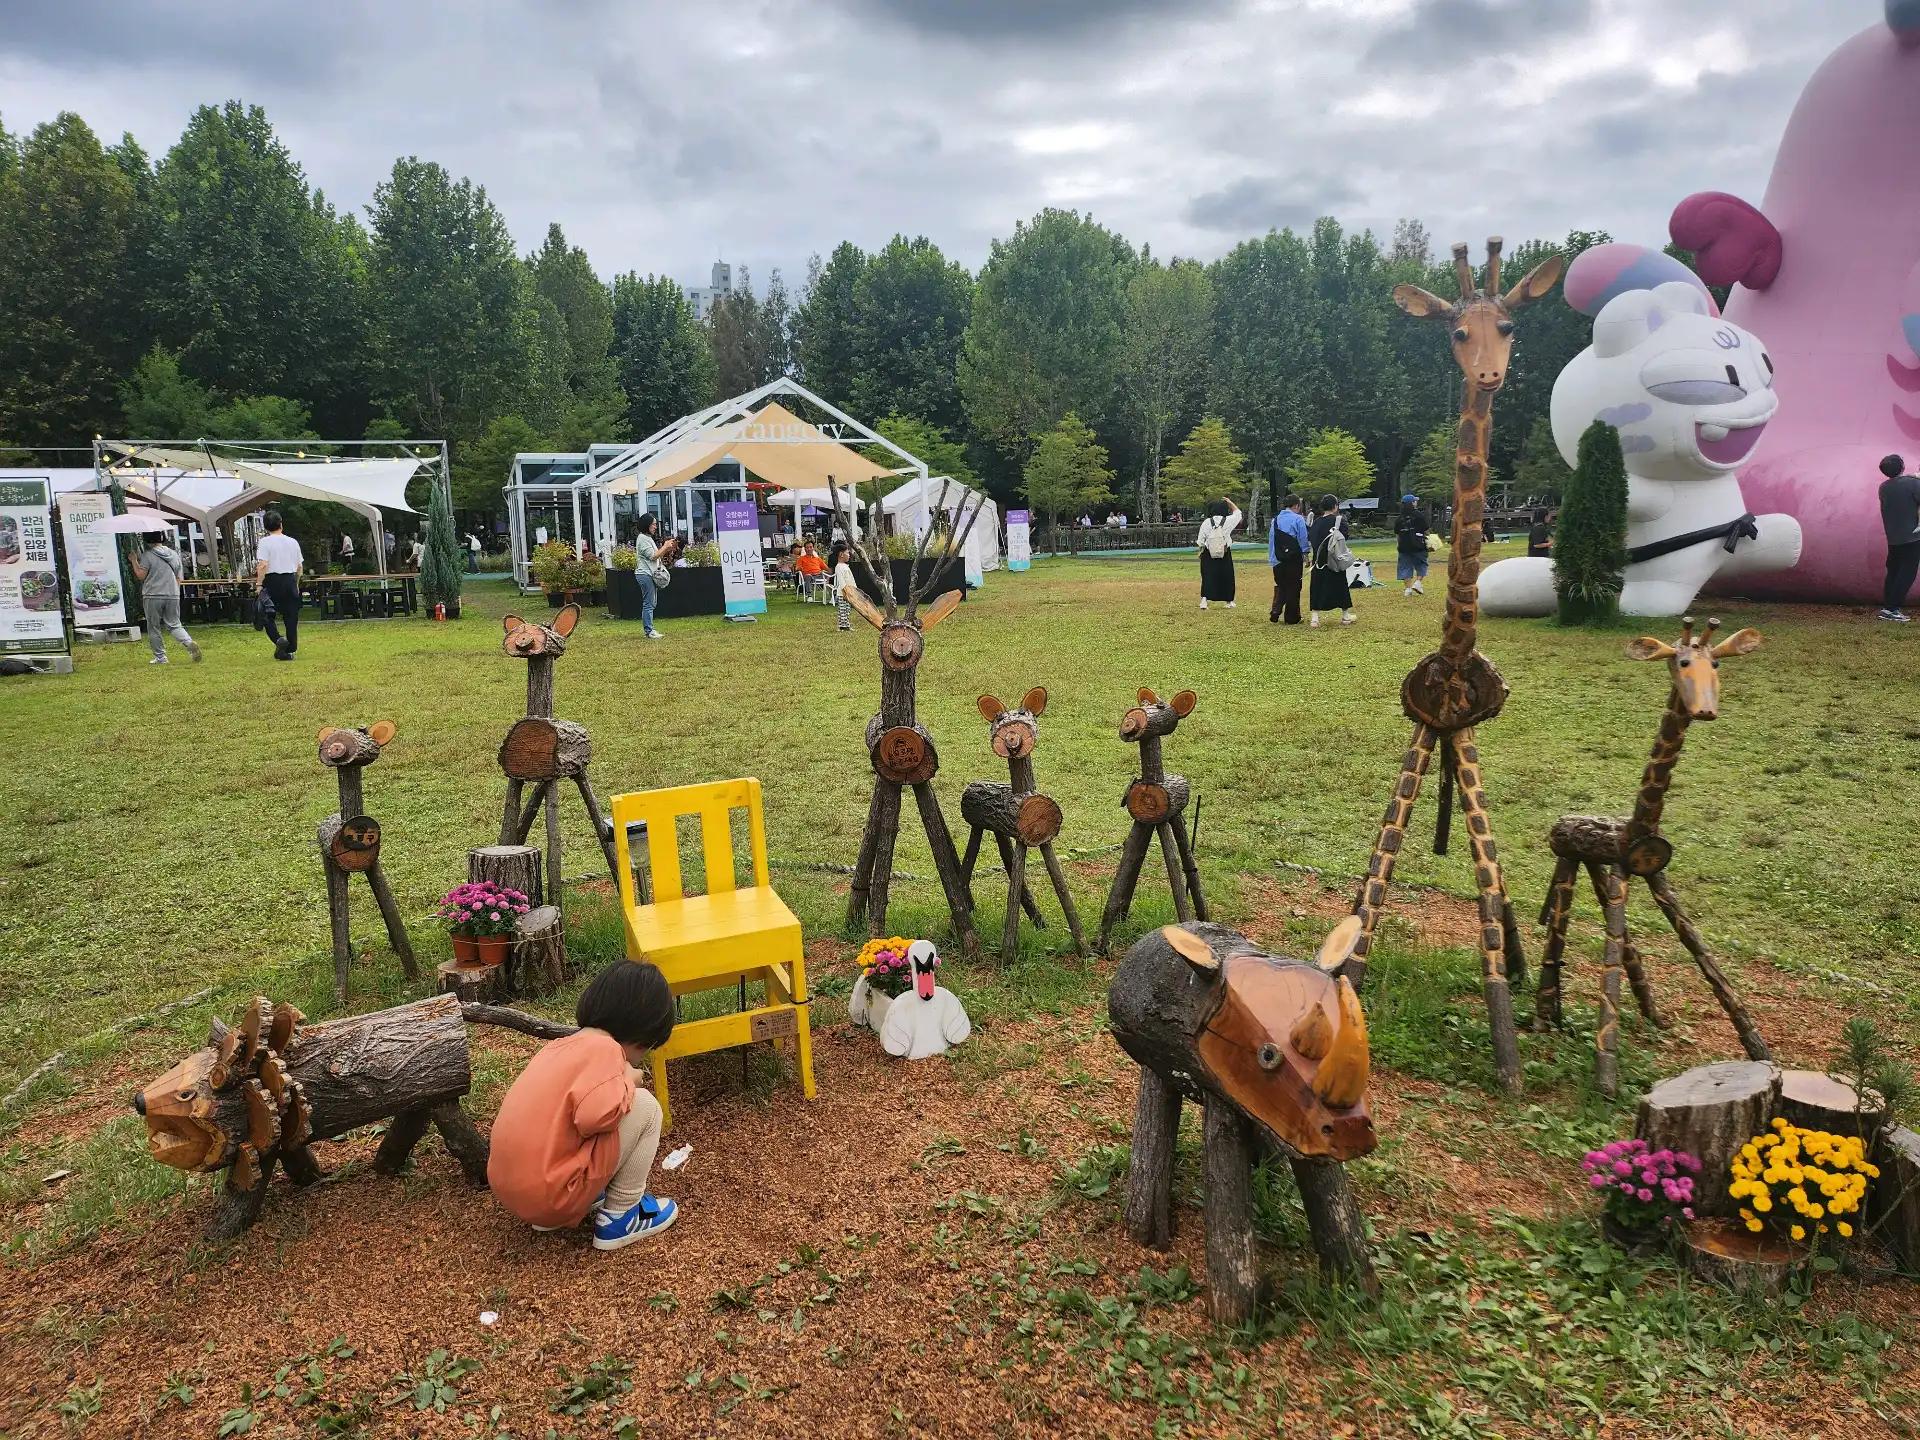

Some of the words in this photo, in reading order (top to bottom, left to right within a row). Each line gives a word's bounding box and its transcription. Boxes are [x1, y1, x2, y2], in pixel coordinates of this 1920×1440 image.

[724, 422, 846, 444] rangery
[21, 516, 44, 526] 반려
[23, 527, 45, 538] 식물
[24, 539, 47, 550] 입양
[26, 551, 48, 562] 체험
[722, 549, 761, 567] 아이스
[731, 569, 756, 585] 크림
